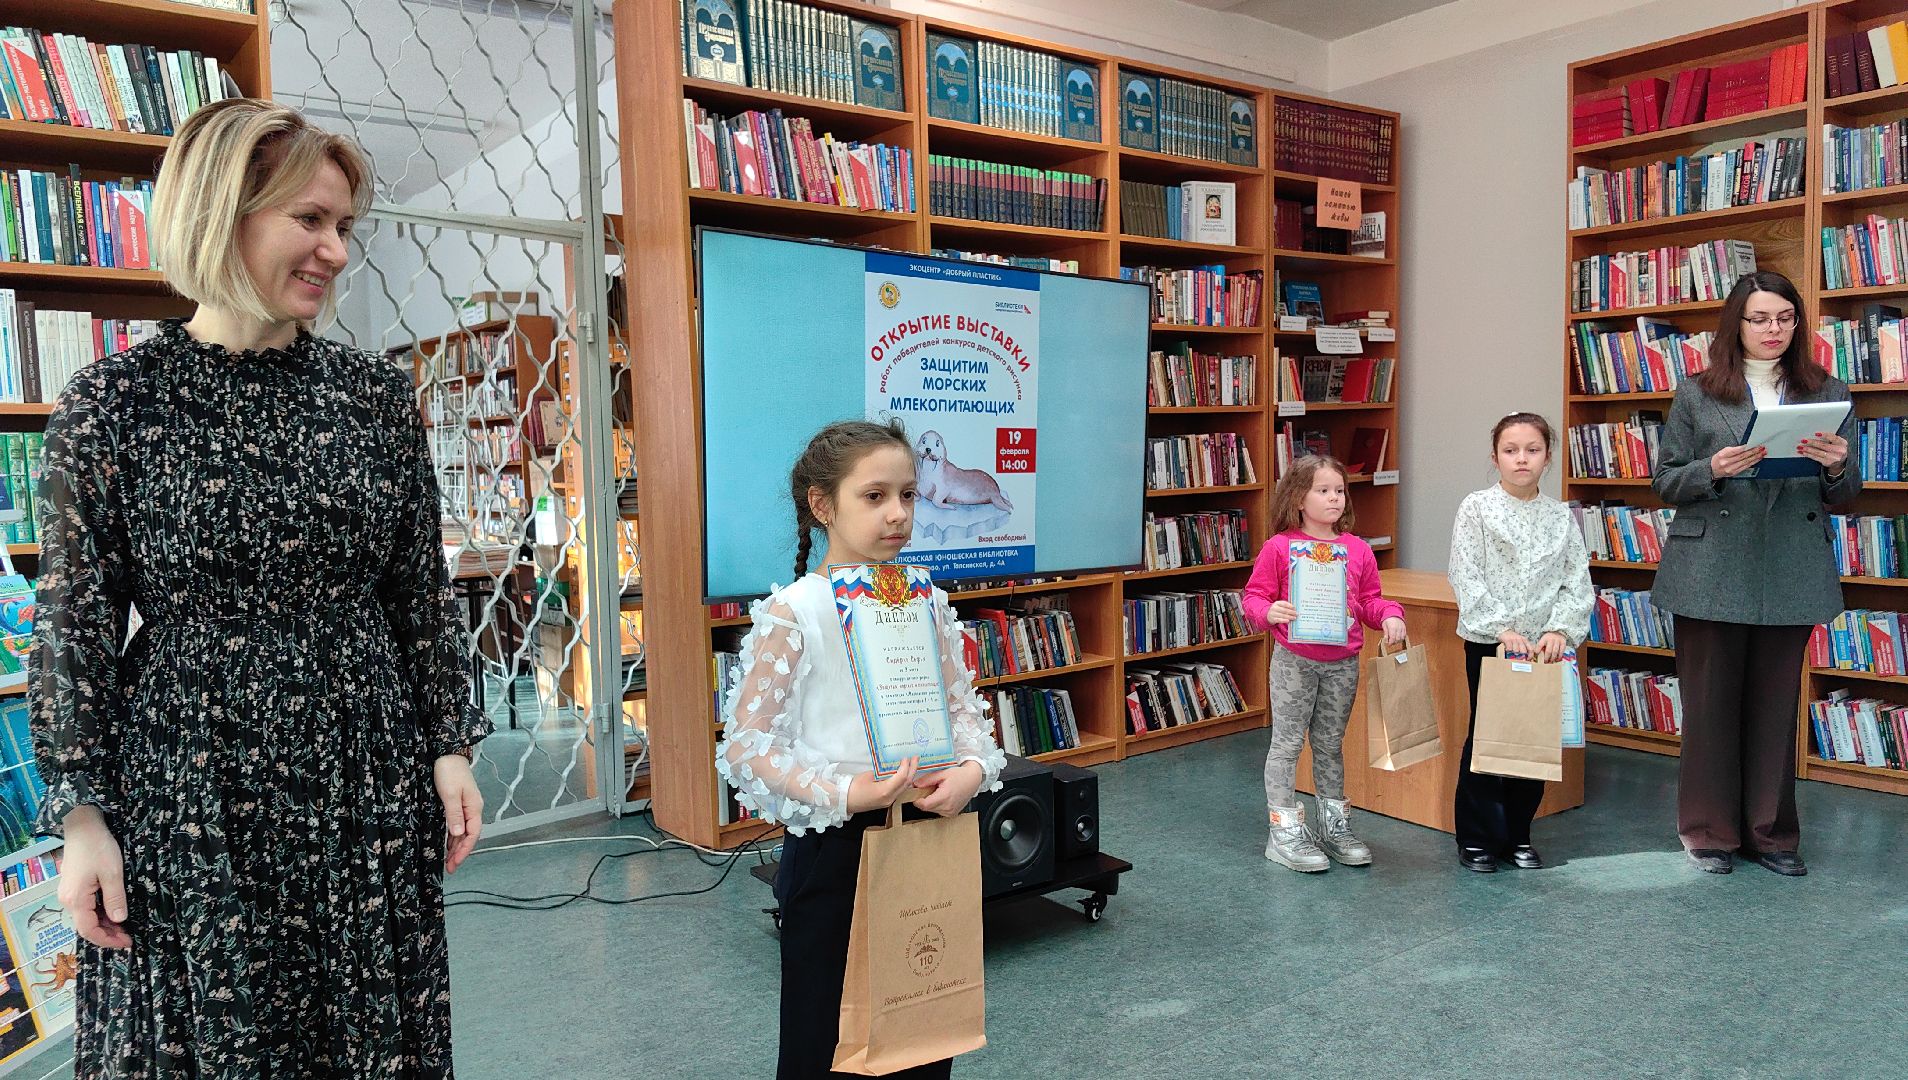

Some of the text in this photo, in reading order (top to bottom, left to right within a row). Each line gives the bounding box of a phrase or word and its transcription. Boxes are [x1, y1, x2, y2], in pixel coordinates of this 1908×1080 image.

[73, 180, 84, 224] ВСЕЛЕННАЯ
[909, 264, 1002, 281] ЭКОЦЕНТР «ДОБРЫЙ ПЛАСТИК»
[870, 314, 1031, 373] ОТКРЫТИЕ ВЫСТАВКИ
[880, 338, 1022, 401] работ победителей конкурса детского рисунка
[920, 357, 989, 375] ЗАЩИТИМ
[922, 376, 987, 392] МОРСКИХ
[890, 396, 1015, 416] МЛЕКОПИТАЮЩИХ
[1008, 431, 1022, 445] 19
[1000, 447, 1030, 456] февраля
[1001, 460, 1028, 470] 14:00
[978, 534, 1027, 544] Вход свободный
[934, 551, 977, 562] ЮНОШЕСКАЯ
[978, 549, 1019, 559] БИБЛИОТЕКА
[875, 610, 919, 626] Диплом
[919, 954, 934, 967] 110
